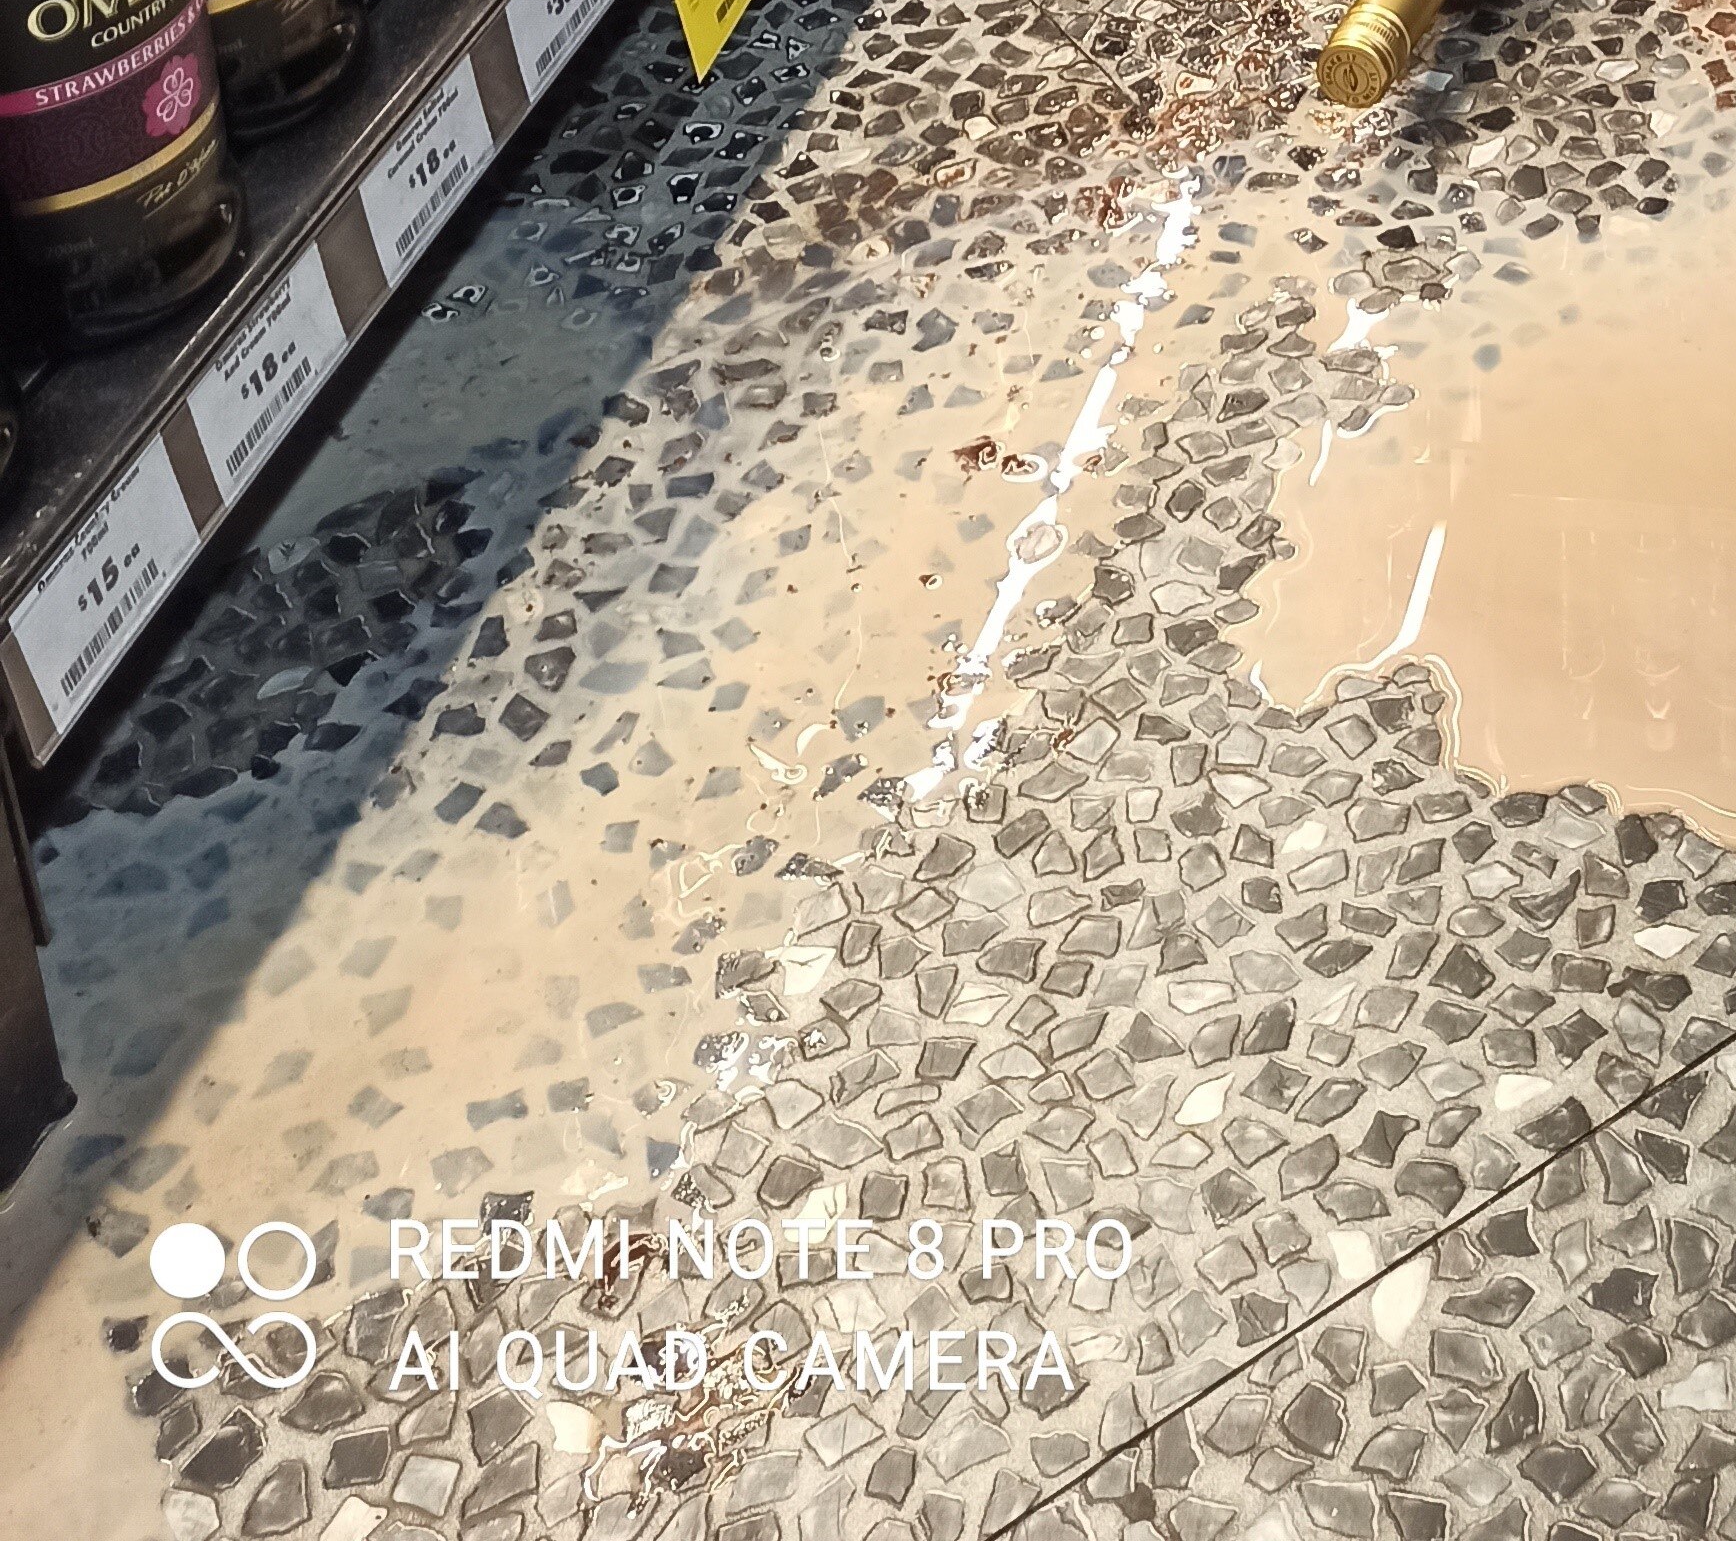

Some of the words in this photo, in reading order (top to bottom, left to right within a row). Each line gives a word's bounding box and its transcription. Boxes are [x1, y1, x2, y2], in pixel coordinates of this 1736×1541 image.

[34, 14, 187, 108] STRAWBERRIES
[240, 350, 278, 401] $18
[77, 553, 121, 613] $15
